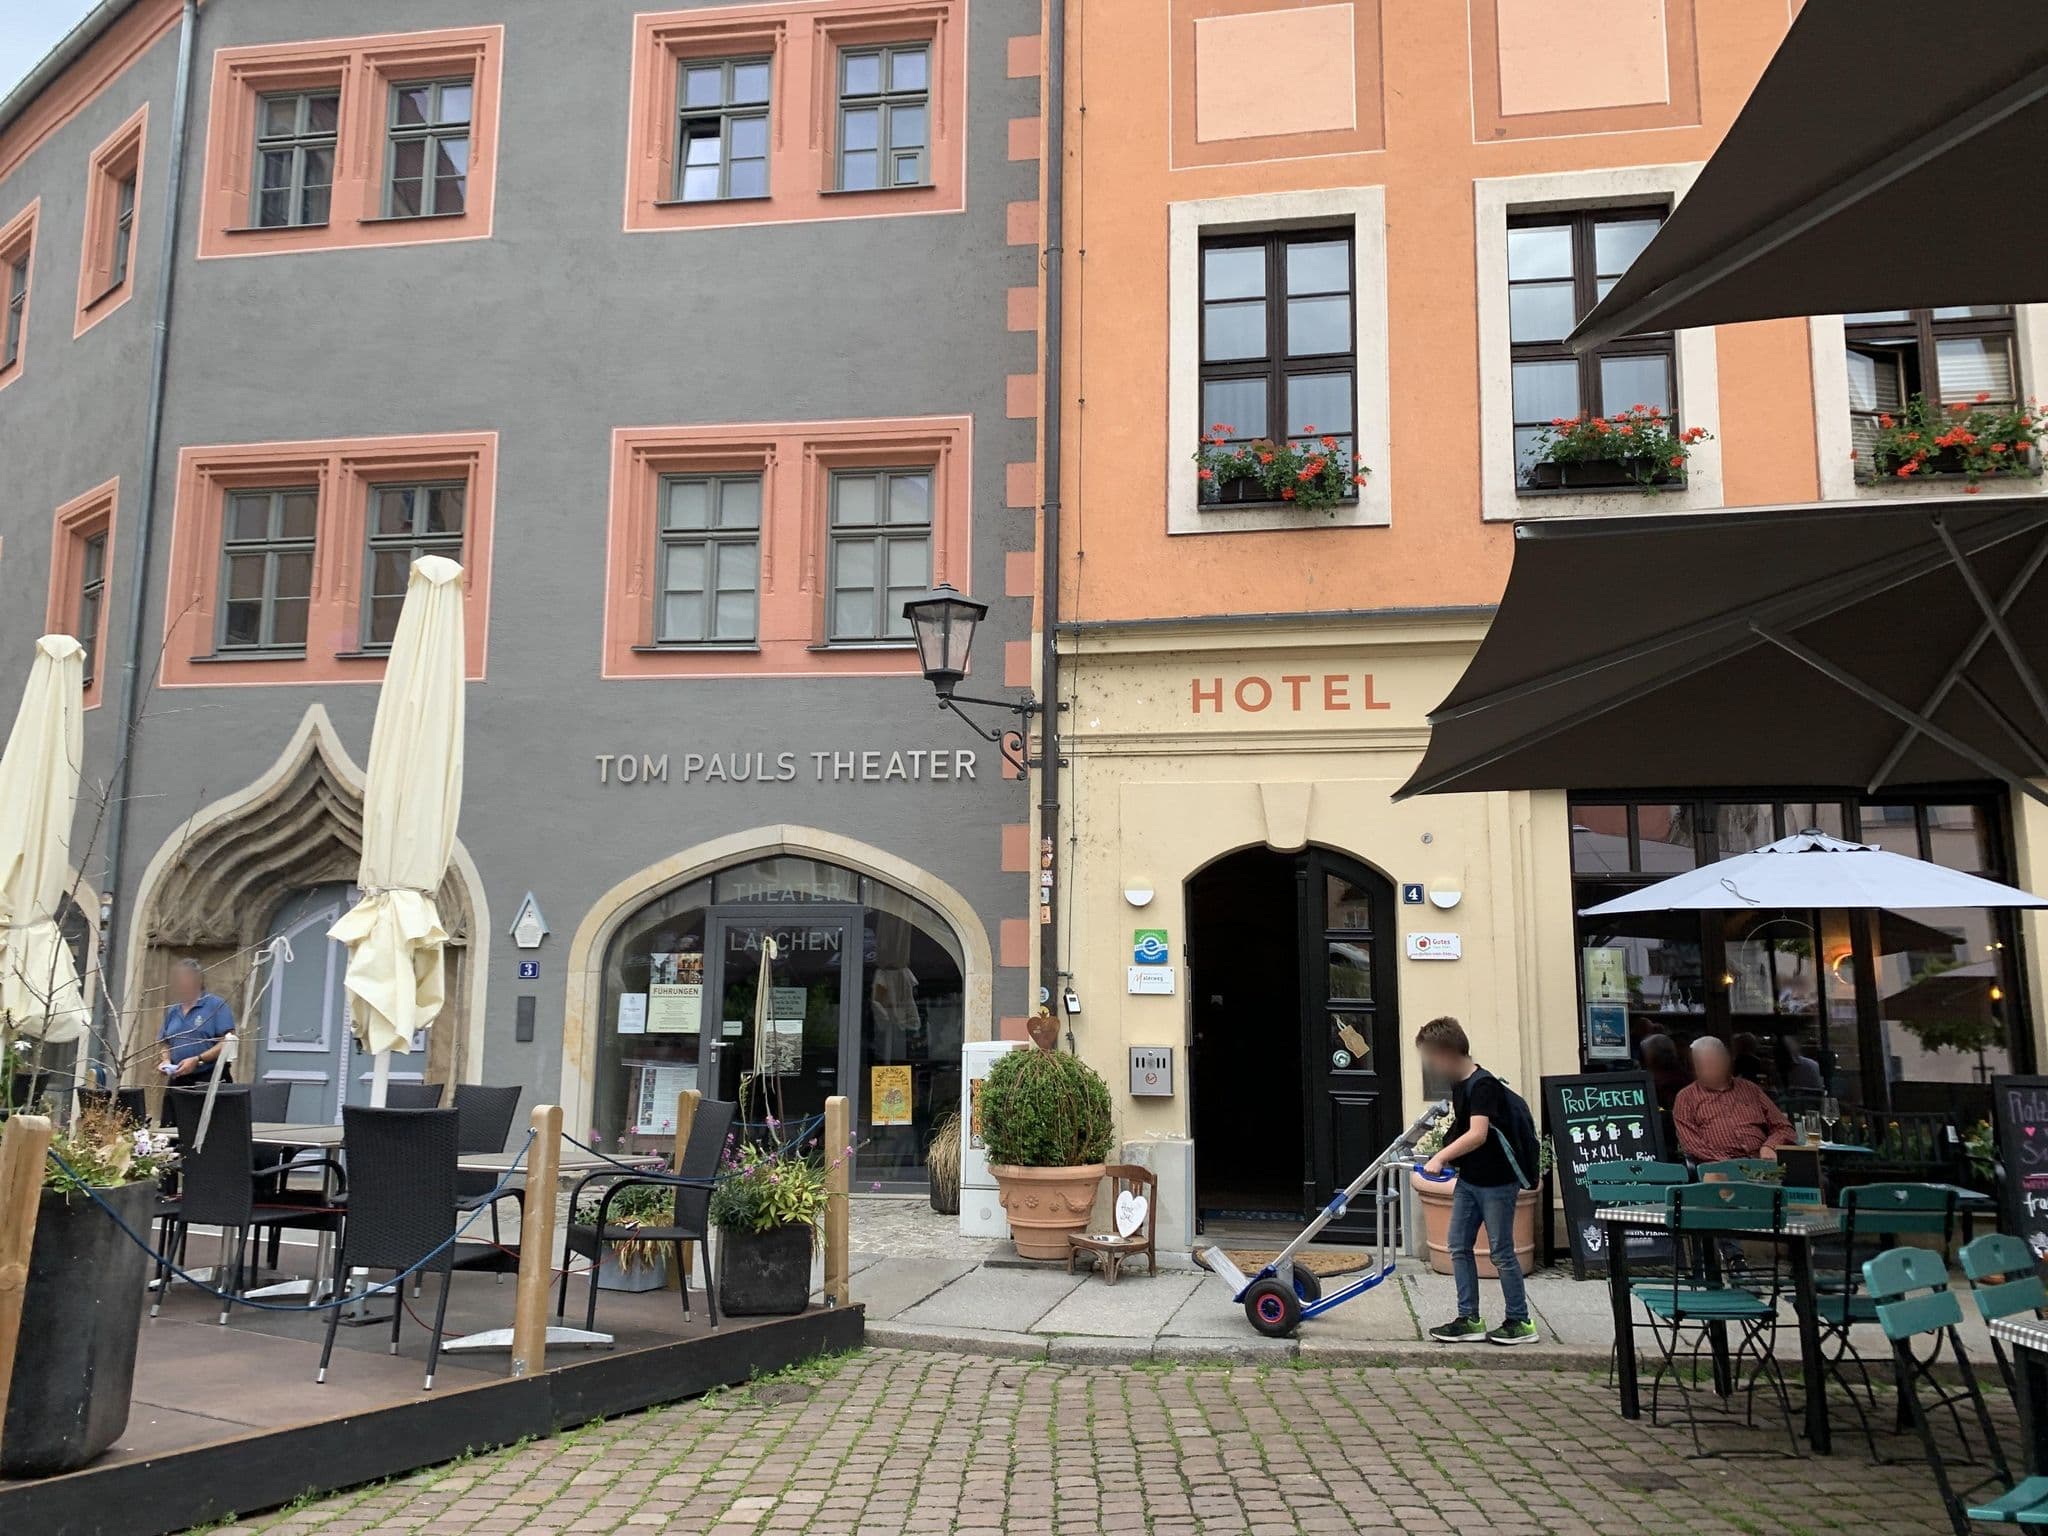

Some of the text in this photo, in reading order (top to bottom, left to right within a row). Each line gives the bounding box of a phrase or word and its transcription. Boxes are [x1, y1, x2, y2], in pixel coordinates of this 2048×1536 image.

[1192, 674, 1391, 713] HOTEL
[596, 749, 977, 783] TOM PAULS THEATER
[733, 883, 841, 902] THEATER
[1408, 888, 1418, 900] 4
[524, 963, 533, 976] 3
[653, 986, 699, 995] FÜHRUNGEN
[1579, 1145, 1589, 1161] 4
